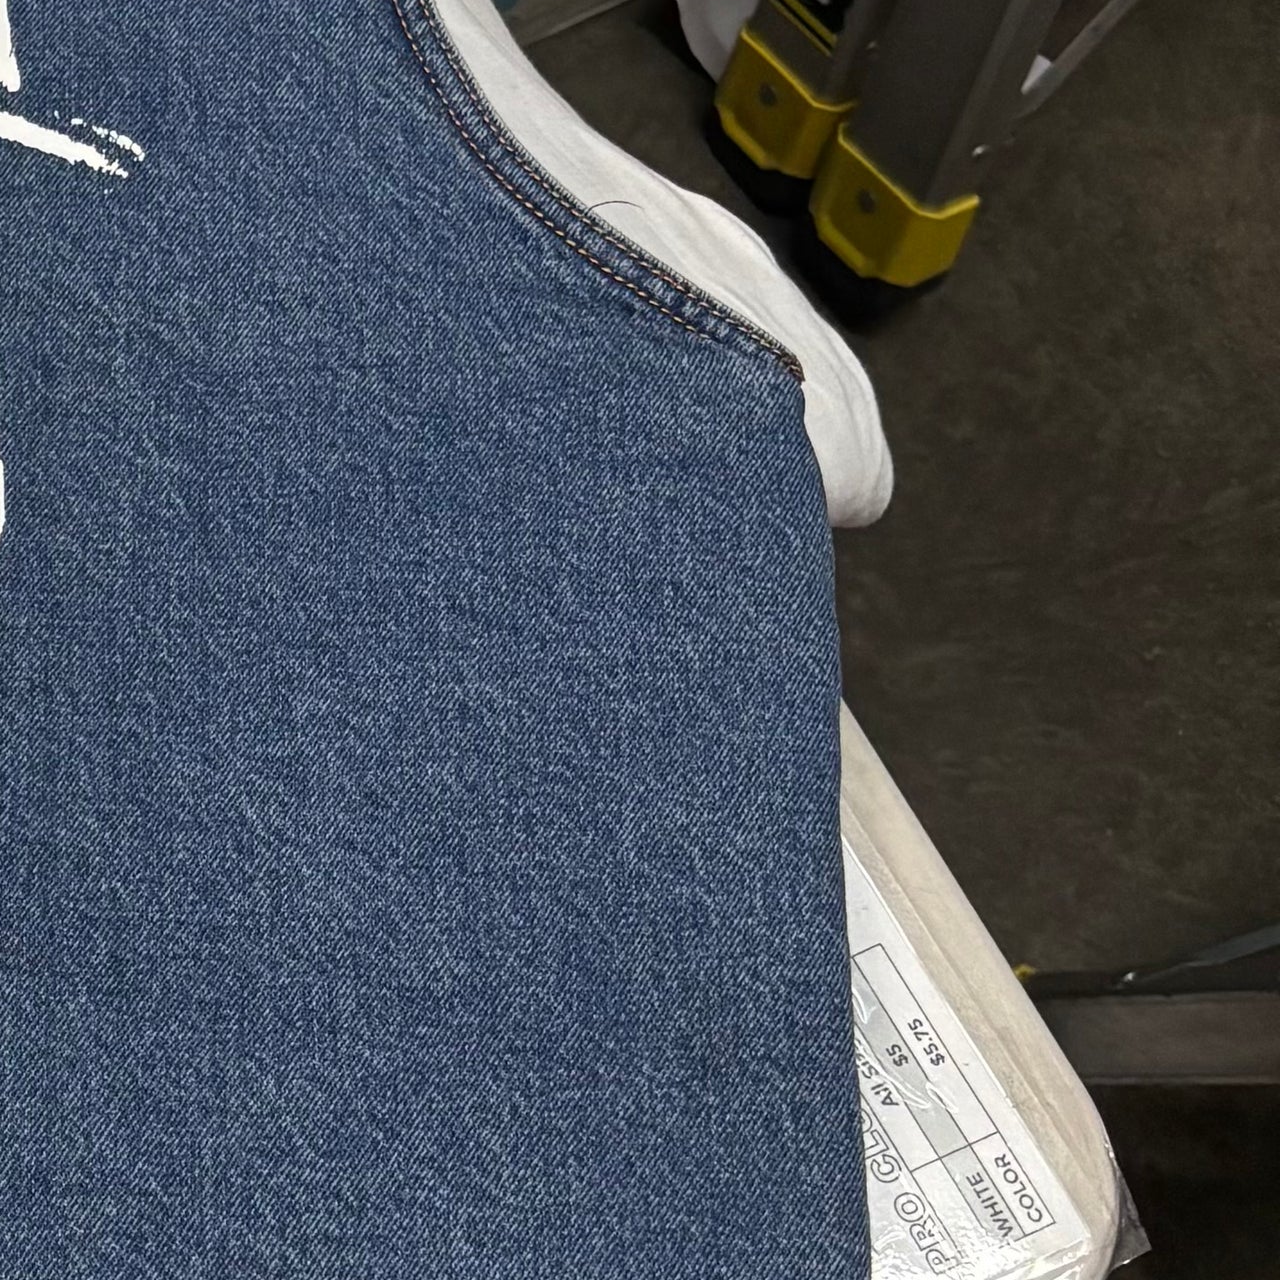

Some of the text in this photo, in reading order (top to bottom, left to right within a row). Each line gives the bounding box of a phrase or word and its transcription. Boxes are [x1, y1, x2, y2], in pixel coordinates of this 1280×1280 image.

[871, 1082, 899, 1107] All
[885, 1043, 1014, 1238] WHITE $5
[907, 1018, 1043, 1222] COLOR $5.75
[894, 1192, 961, 1275] PRO
